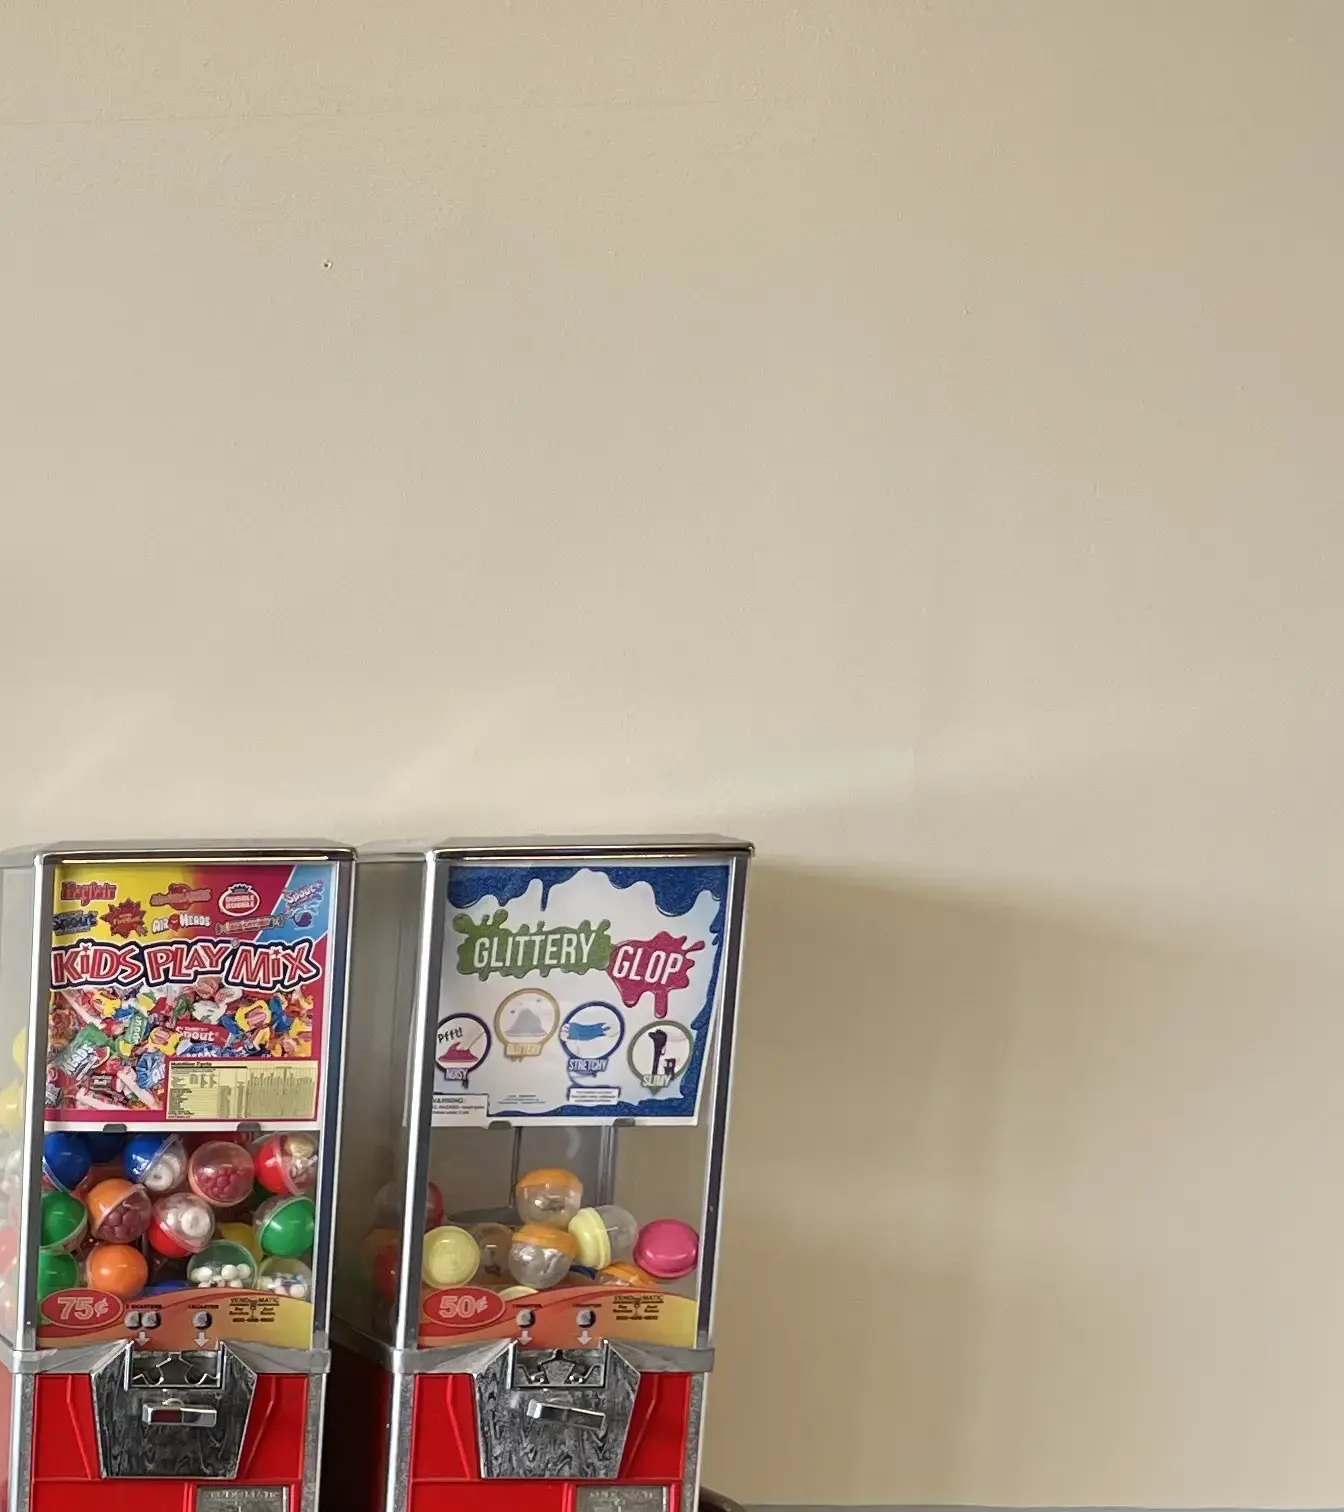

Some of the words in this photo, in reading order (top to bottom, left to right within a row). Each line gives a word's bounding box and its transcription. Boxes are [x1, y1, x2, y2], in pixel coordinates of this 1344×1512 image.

[146, 942, 231, 982] PLAY
[473, 933, 596, 968] GLITTERY
[612, 946, 683, 985] GLOP
[57, 1296, 109, 1320] 75¢
[439, 1295, 488, 1319] 50¢
